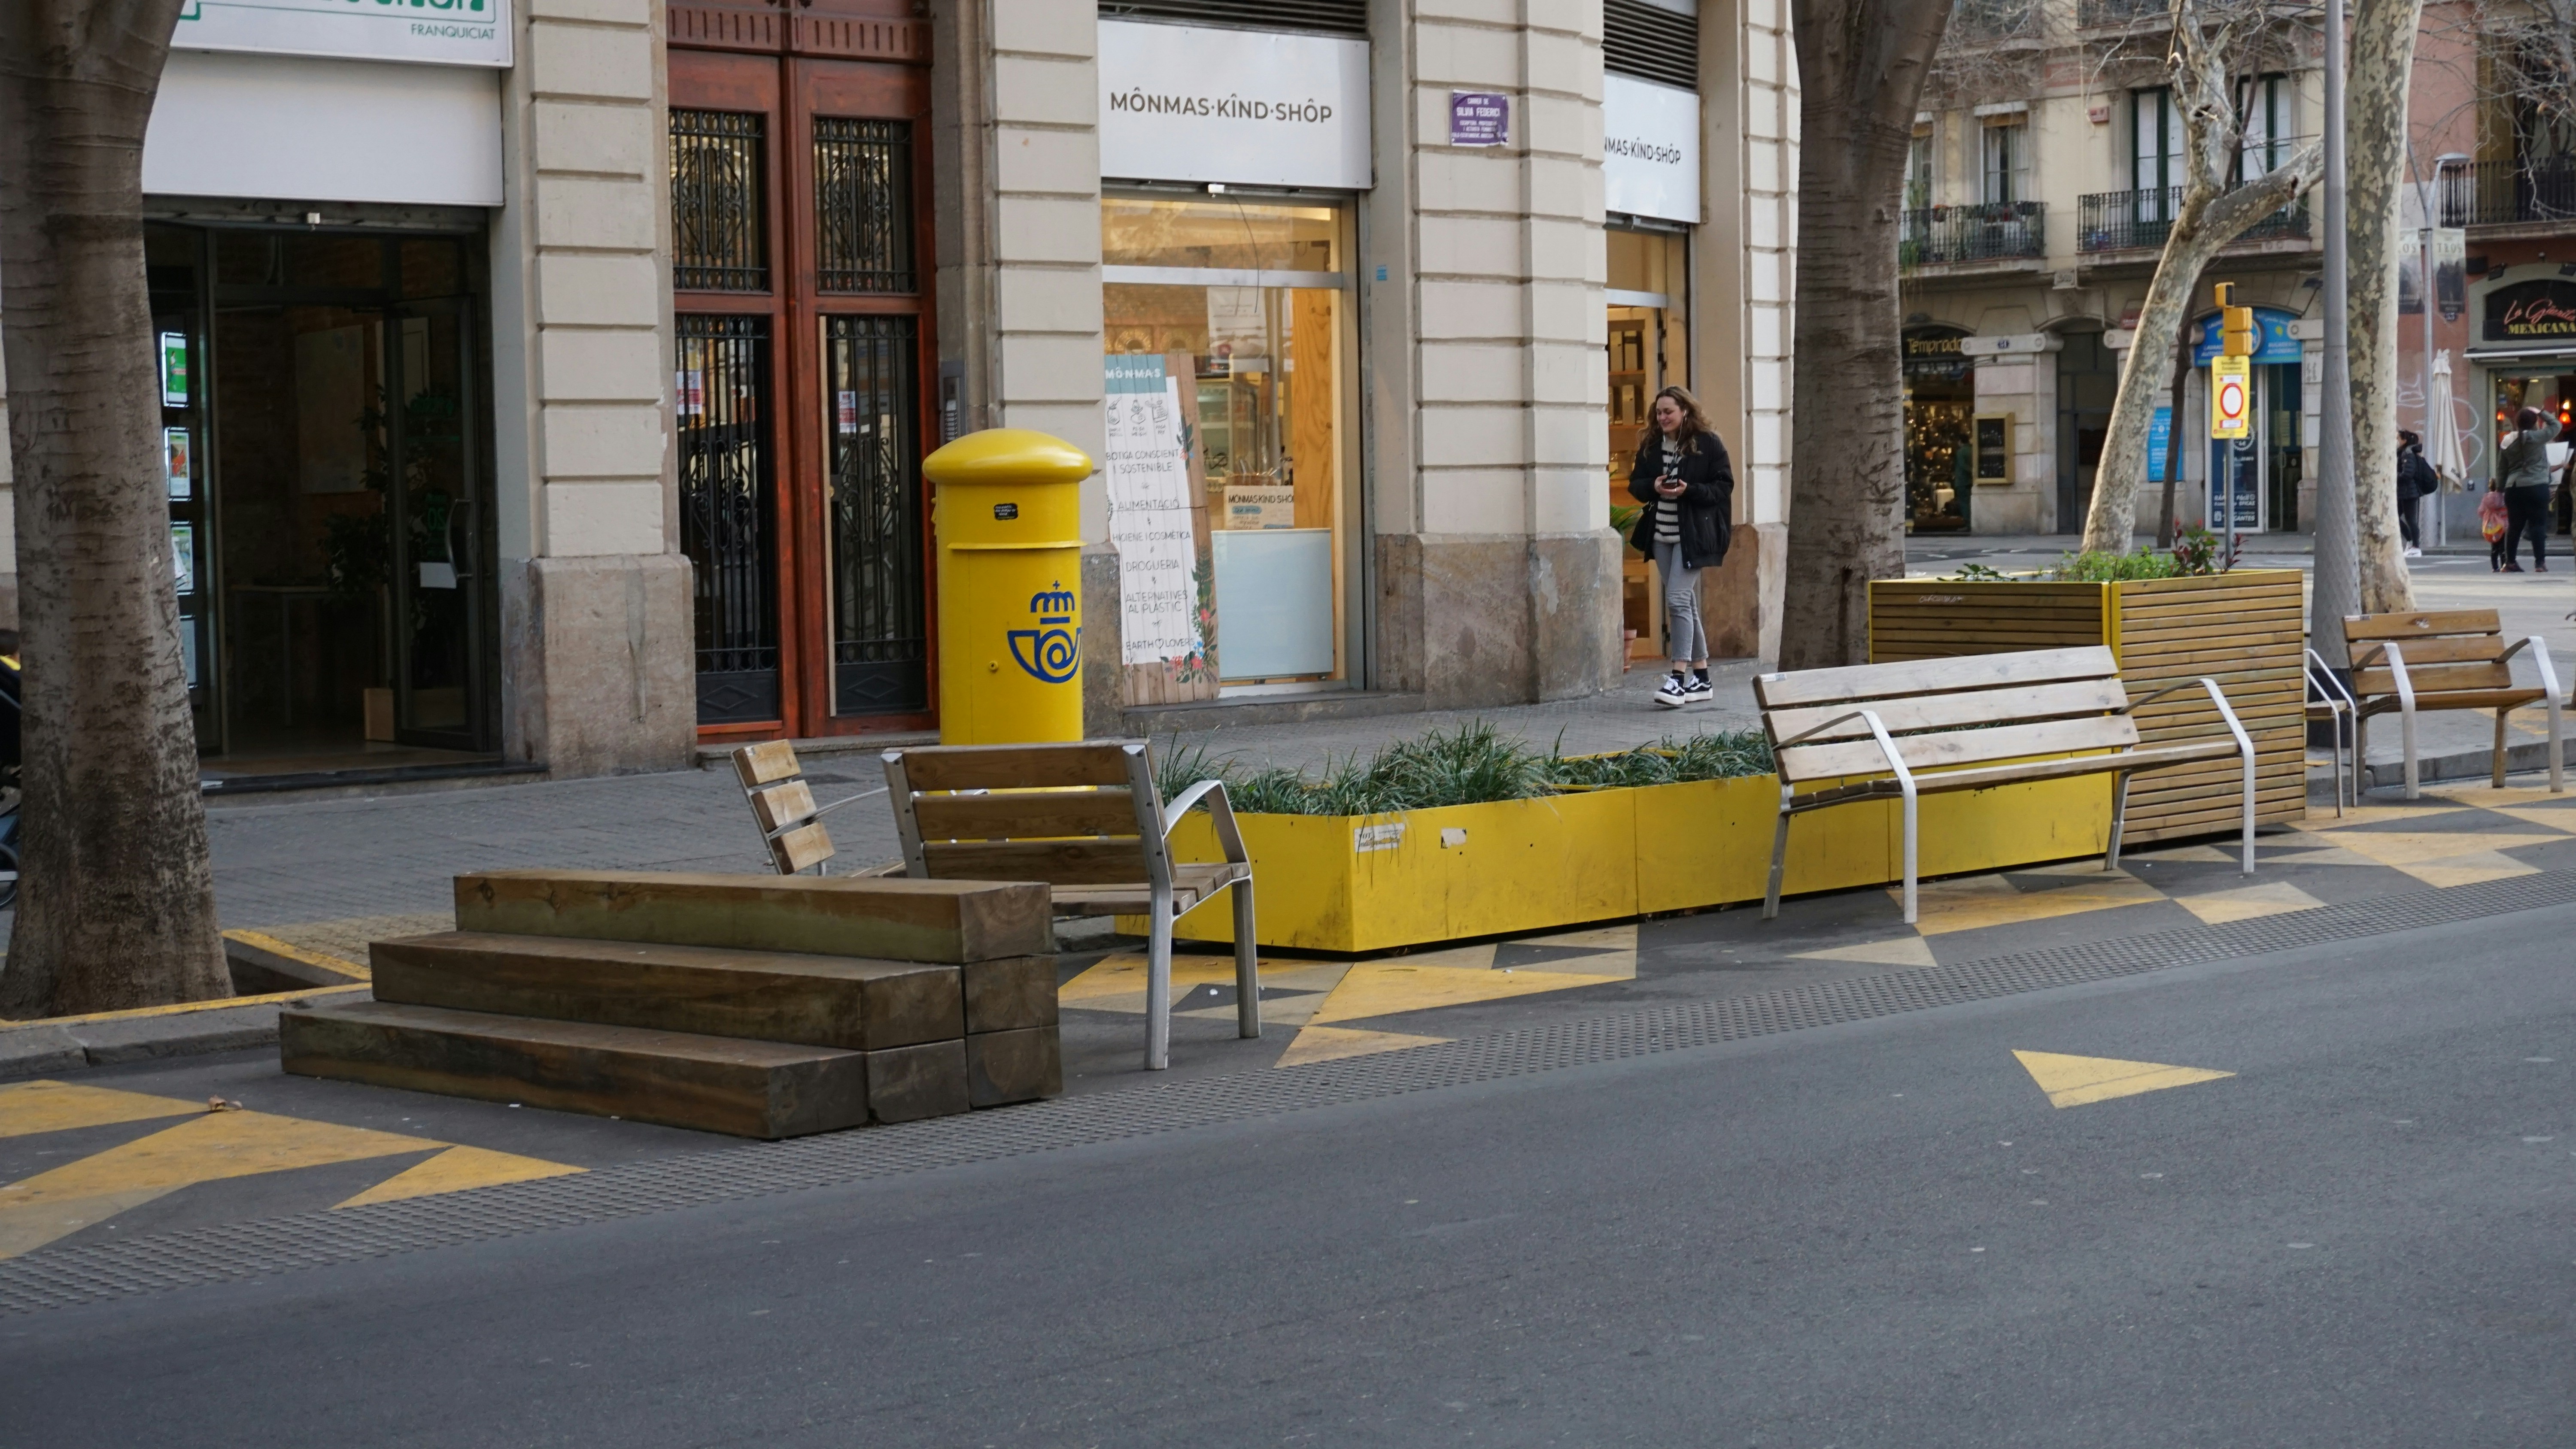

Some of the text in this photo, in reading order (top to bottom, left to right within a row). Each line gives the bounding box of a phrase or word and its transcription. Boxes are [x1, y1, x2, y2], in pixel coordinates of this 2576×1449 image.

[411, 24, 495, 40] FRANQUICIAT
[1106, 449, 1179, 461] BOTIGA CONSCIENT
[1119, 461, 1173, 474] SOSTENIBLE
[1113, 532, 1144, 543] HIGIENE
[1126, 559, 1179, 572] DROGUERIA
[1125, 589, 1188, 603] ALTERNATIVES
[1126, 639, 1195, 650] EARTH LOVERS
